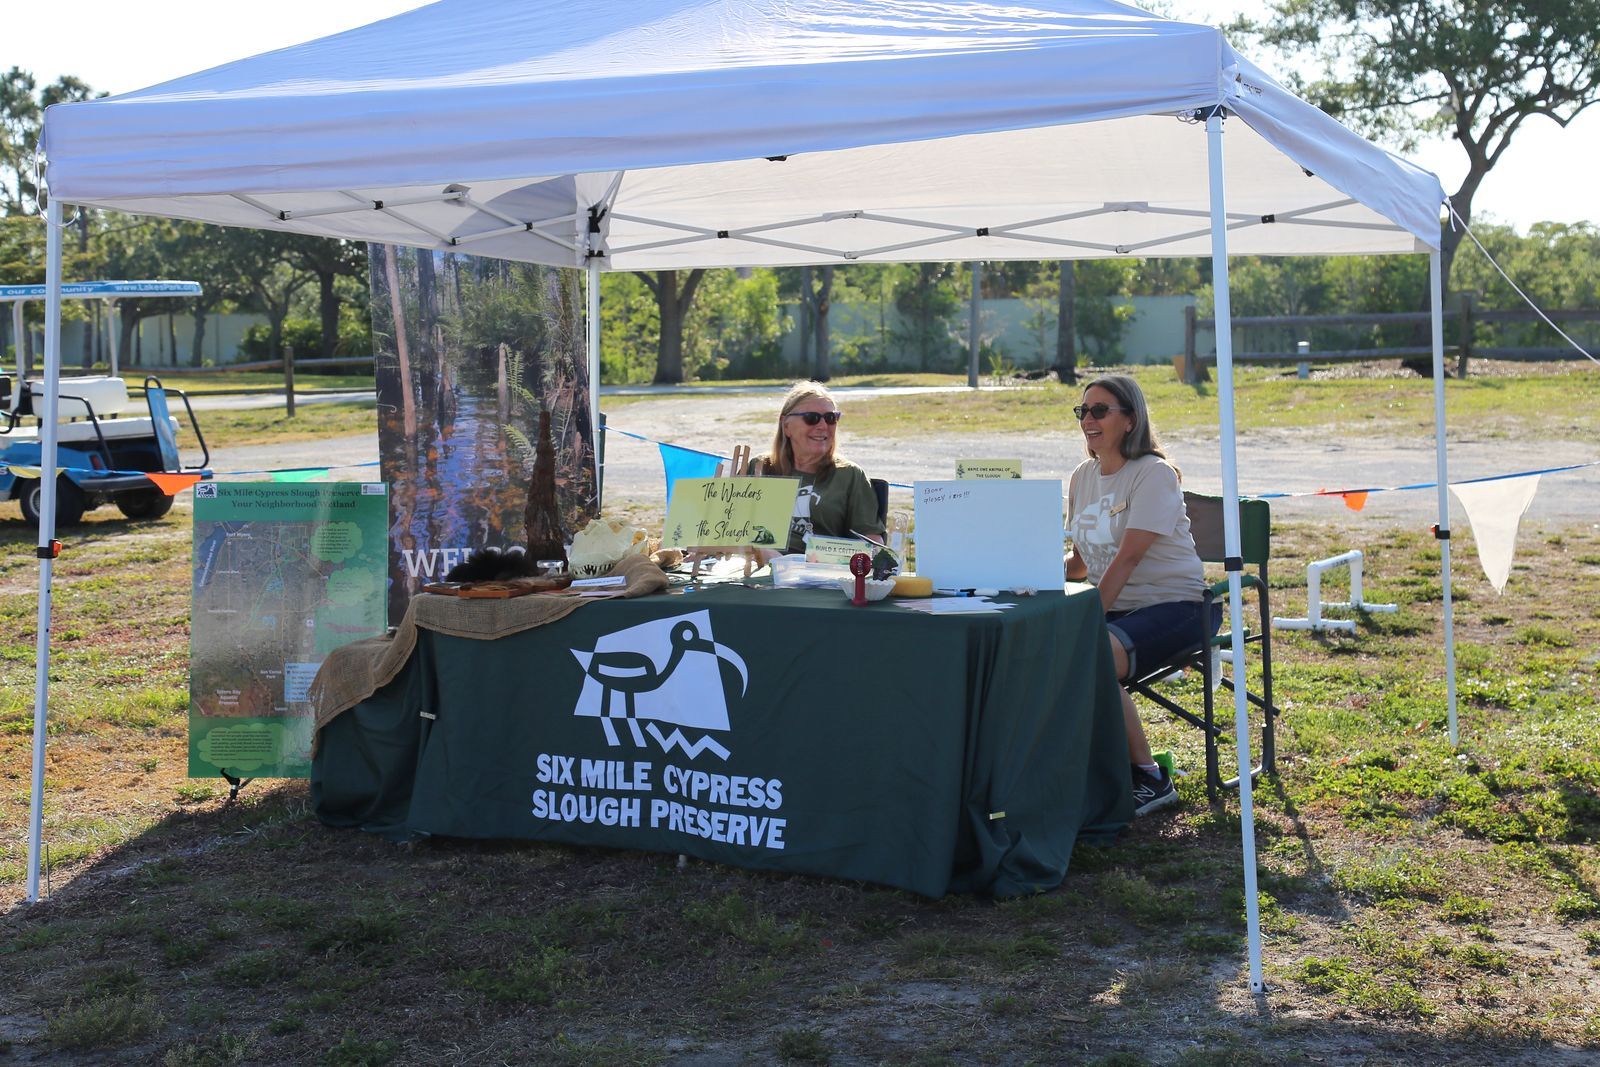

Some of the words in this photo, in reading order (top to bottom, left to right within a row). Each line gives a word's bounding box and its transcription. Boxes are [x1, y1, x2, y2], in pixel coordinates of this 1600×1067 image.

[30, 284, 95, 294] counity
[234, 488, 253, 496] Mile
[255, 488, 289, 498] Cypress
[291, 487, 320, 498] Slough
[702, 482, 718, 501] The
[720, 482, 763, 503] Wonders
[232, 500, 253, 508] Your
[255, 500, 317, 509] Neighborhood
[724, 502, 735, 520] of
[714, 520, 751, 542] Slough
[536, 753, 575, 786] SIX
[581, 759, 652, 791] MILE
[663, 764, 783, 810] CYPRESS
[532, 789, 641, 828] SLOUGH
[650, 798, 787, 850] PRESERVE
